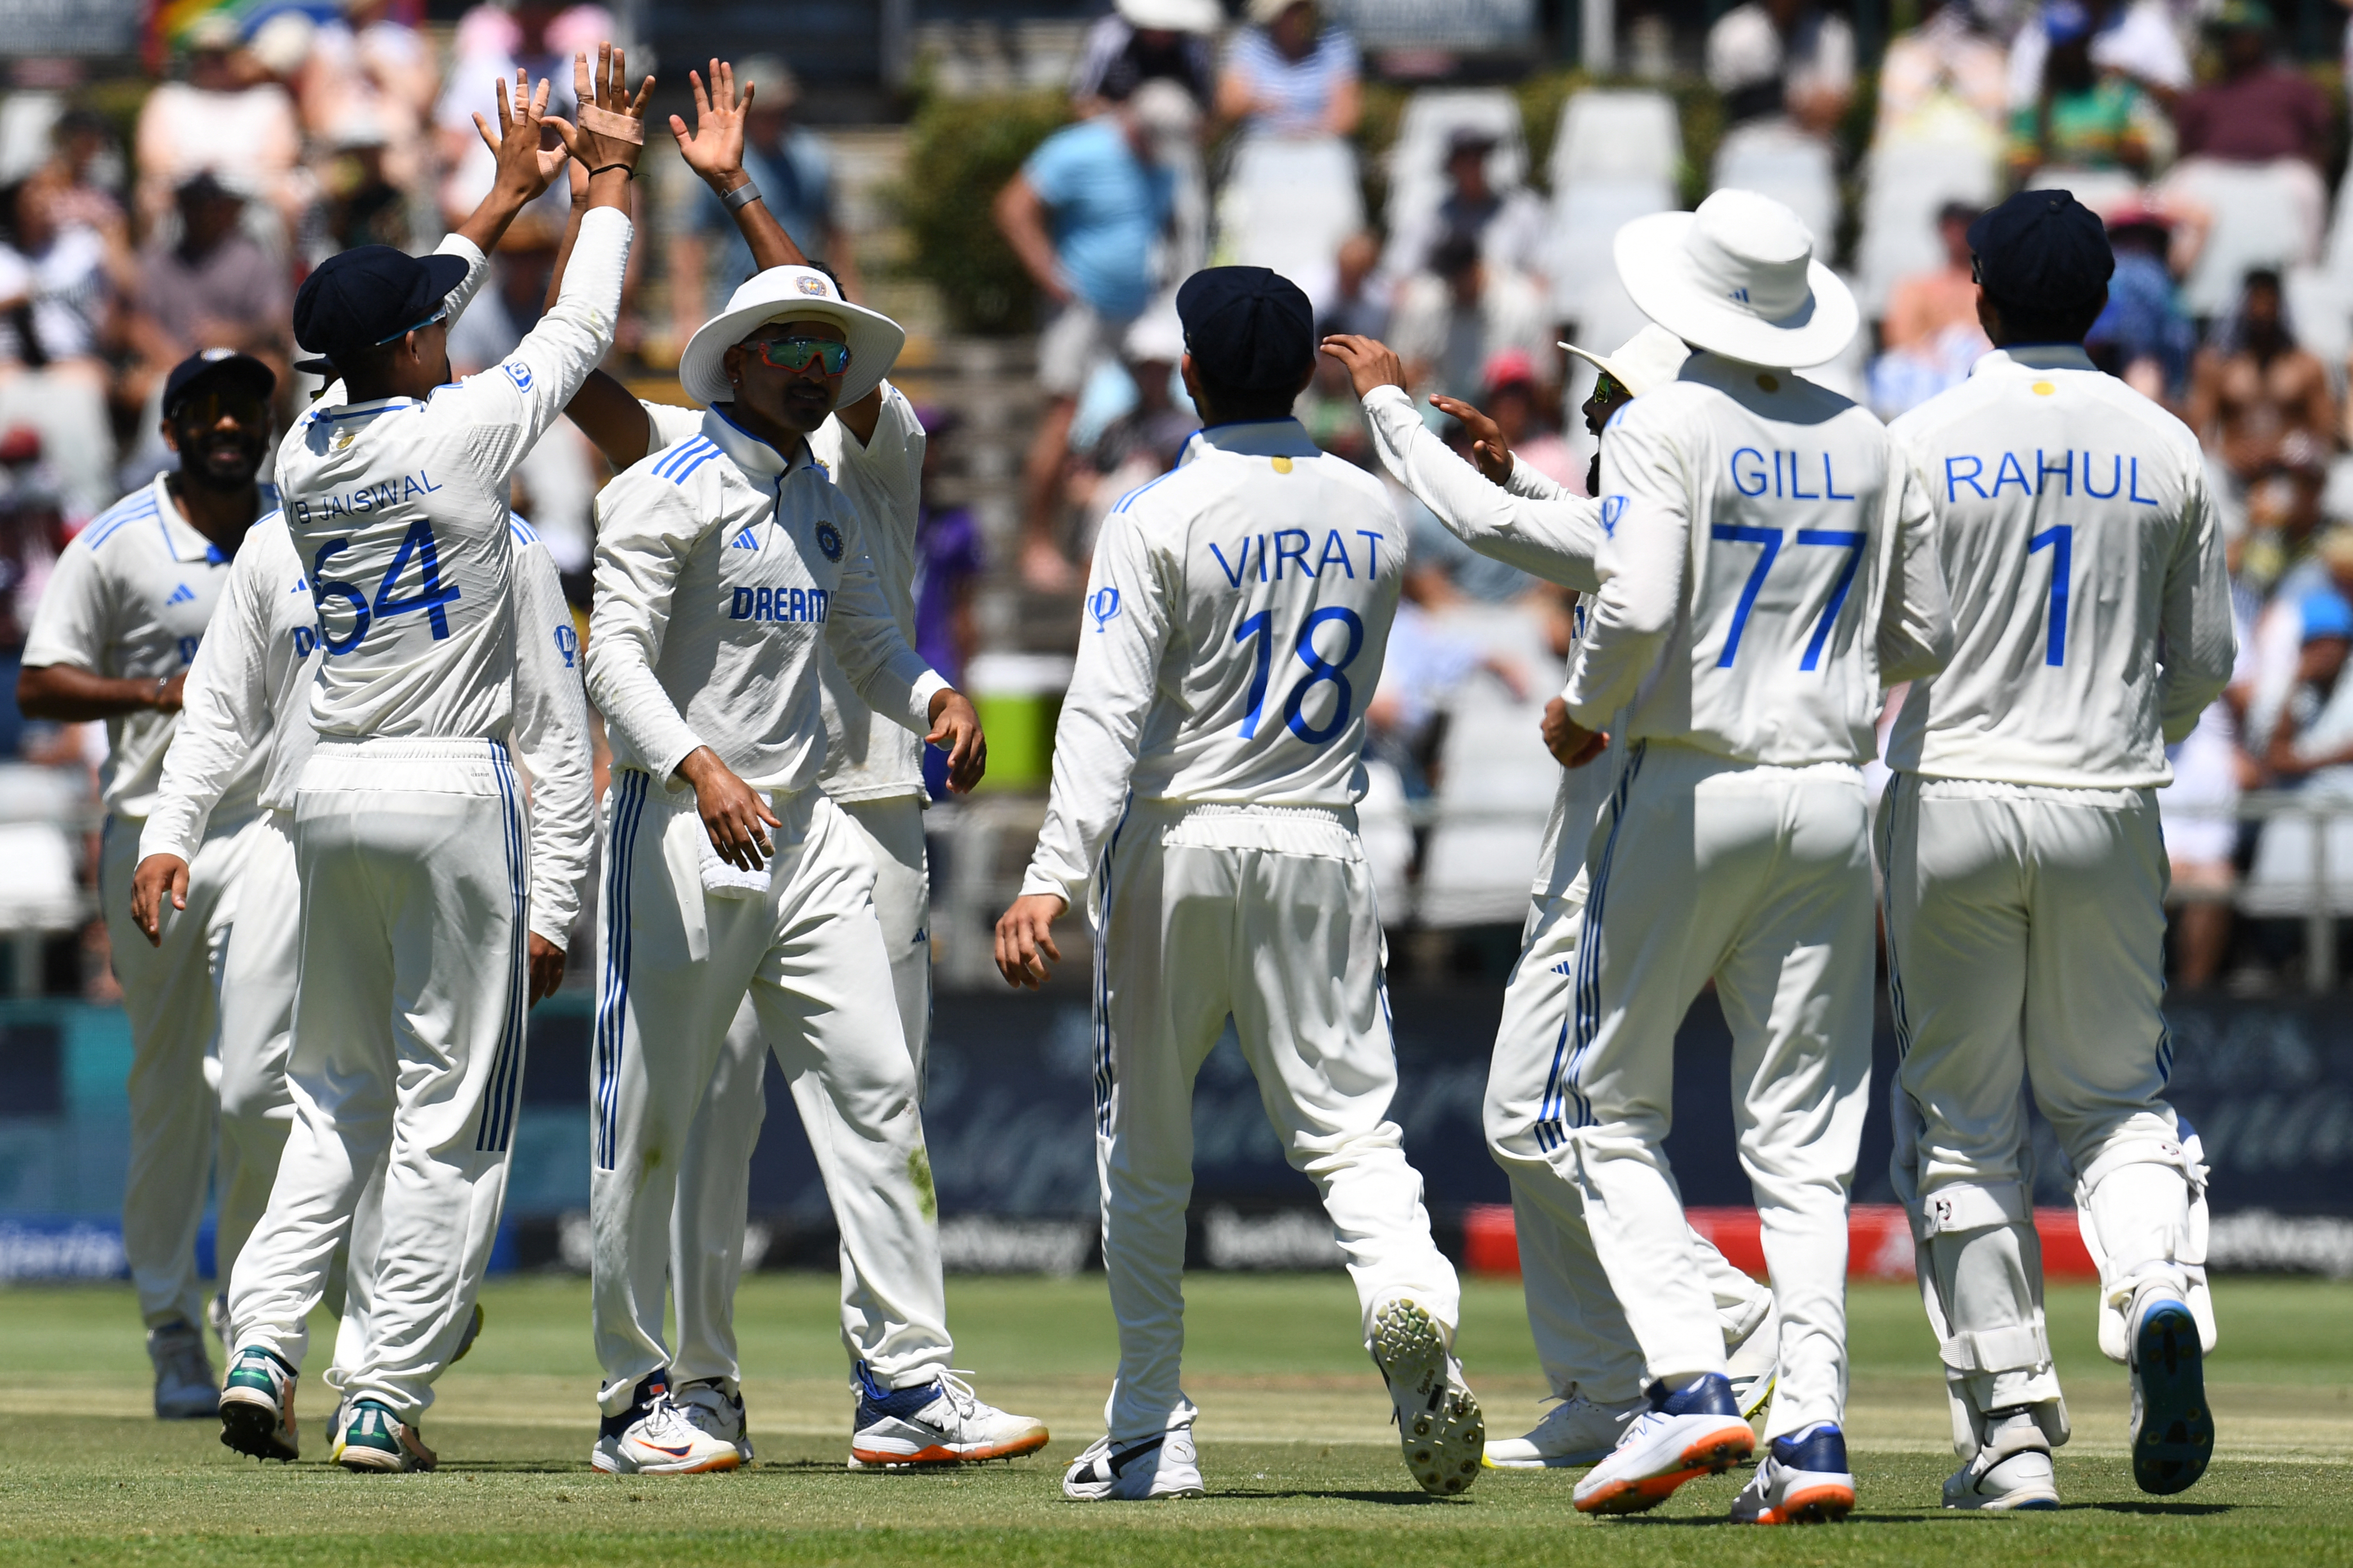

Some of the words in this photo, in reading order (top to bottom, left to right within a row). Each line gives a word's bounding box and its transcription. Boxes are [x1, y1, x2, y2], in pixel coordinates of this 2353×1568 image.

[319, 469, 443, 521] JAISWAL
[1730, 447, 1855, 501] GILL
[1945, 449, 2158, 506] RAHUL
[312, 520, 461, 656] 64
[1209, 529, 1384, 589] VIRAT
[1712, 524, 1867, 672] 77
[2028, 524, 2073, 668] 1
[1233, 606, 1364, 745] 18
